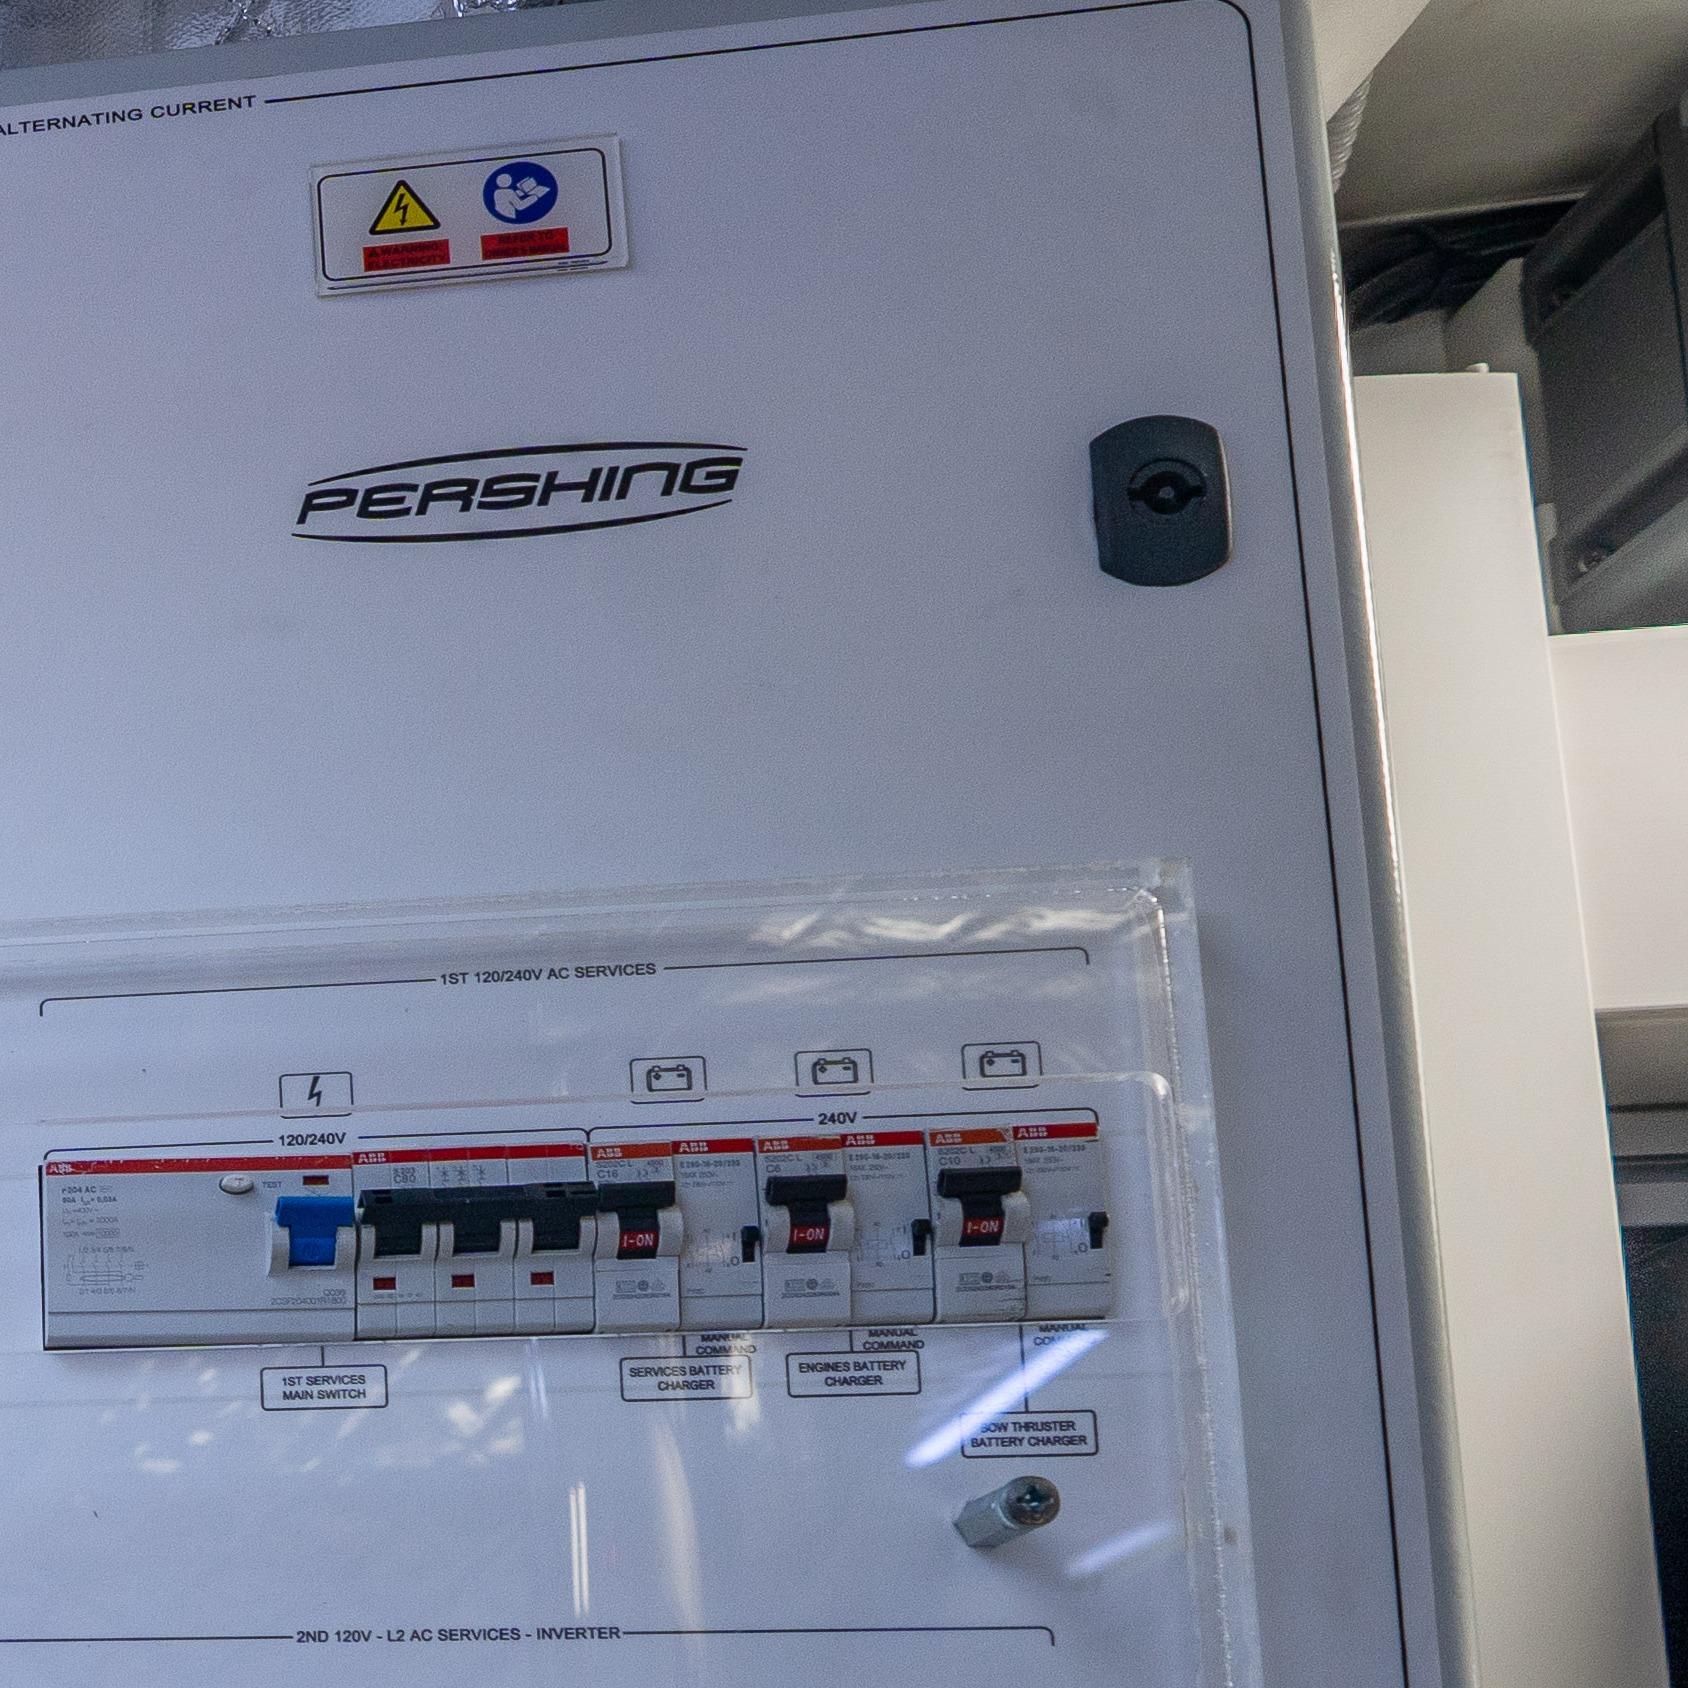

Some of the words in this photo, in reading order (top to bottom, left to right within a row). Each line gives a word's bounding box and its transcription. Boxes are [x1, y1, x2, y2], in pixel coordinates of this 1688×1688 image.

[151, 95, 256, 118] CURRENT
[296, 457, 743, 525] PERSHING
[441, 972, 469, 985] 1ST
[475, 968, 543, 983] 120/240V
[547, 967, 569, 980] AC
[575, 962, 656, 978] SERVICES
[818, 1112, 857, 1125] 240V
[279, 1132, 346, 1146] 120/240V
[359, 1152, 387, 1163] ABB
[629, 1366, 686, 1377] SERVICES
[689, 1365, 742, 1377] BATTERY
[282, 1376, 303, 1386] 1ST
[306, 1375, 366, 1386] SERVICES
[657, 1379, 715, 1391] CHARGER
[283, 1390, 314, 1400] MAIN
[317, 1389, 366, 1399] SWITCH
[1011, 1420, 1076, 1432] THRUSTER
[971, 1437, 1025, 1448] BATTERY
[1028, 1435, 1087, 1447] CHARGER
[297, 1630, 329, 1643] 2ND
[335, 1630, 372, 1642] 120V
[387, 1629, 405, 1641] L2
[410, 1629, 433, 1642] AC
[438, 1628, 521, 1641] SERVICES
[537, 1627, 620, 1640] INVERTER
